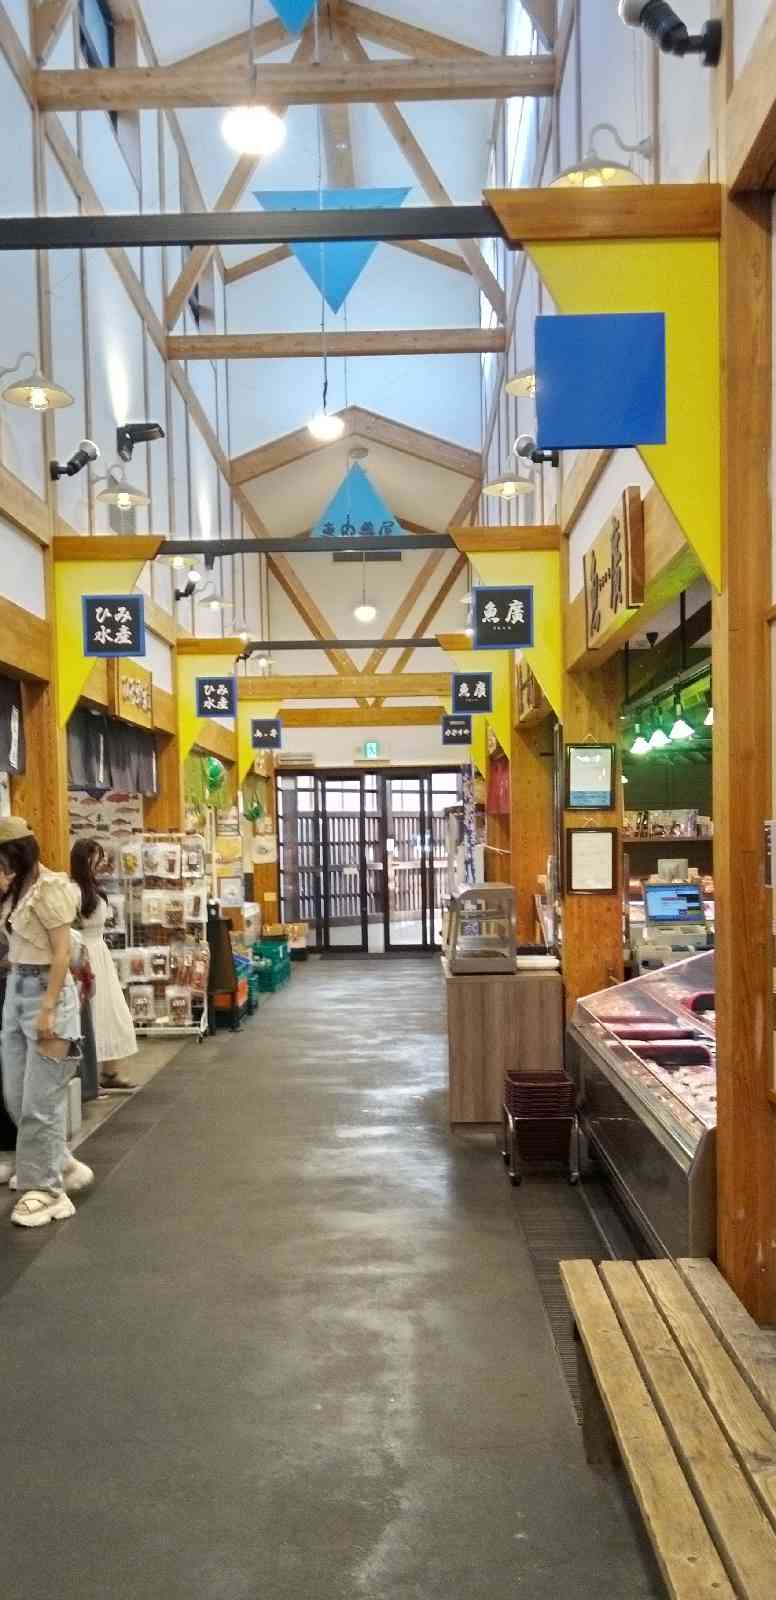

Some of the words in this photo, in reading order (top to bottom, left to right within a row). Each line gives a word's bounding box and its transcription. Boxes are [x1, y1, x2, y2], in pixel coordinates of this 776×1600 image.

[95, 606, 132, 623] ひみ
[482, 600, 525, 624] 魚廣
[94, 625, 132, 644] 水産
[203, 684, 228, 695] ひみ
[203, 696, 228, 709] 水産
